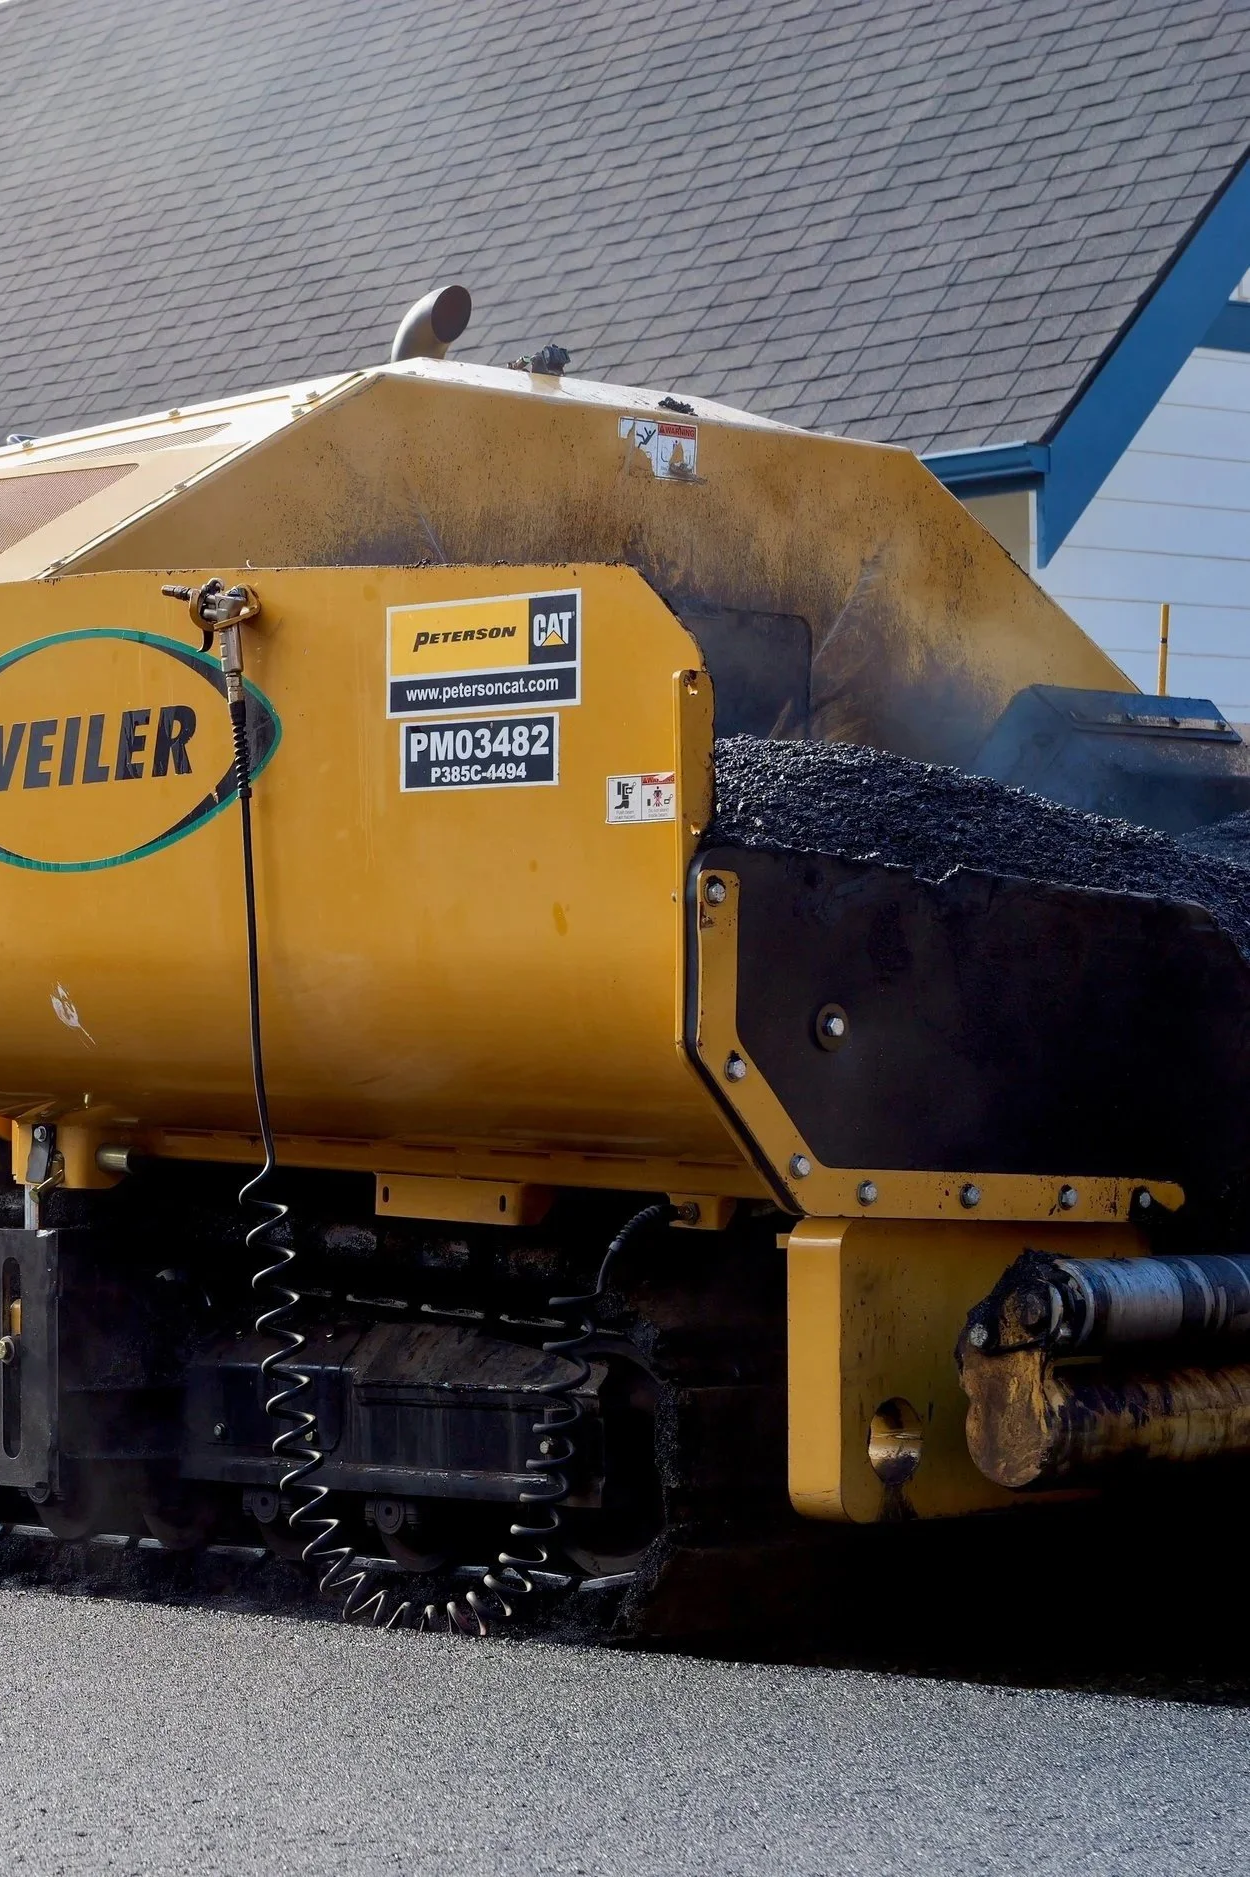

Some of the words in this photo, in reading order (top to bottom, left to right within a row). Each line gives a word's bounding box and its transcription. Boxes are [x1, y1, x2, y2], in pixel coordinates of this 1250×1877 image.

[664, 426, 695, 437] WARNING
[412, 625, 517, 652] PETERSON
[533, 611, 573, 647] CAT
[406, 677, 559, 703] www.petersoncat.com
[410, 724, 550, 763] PM03482
[430, 762, 527, 784] P385C-4494
